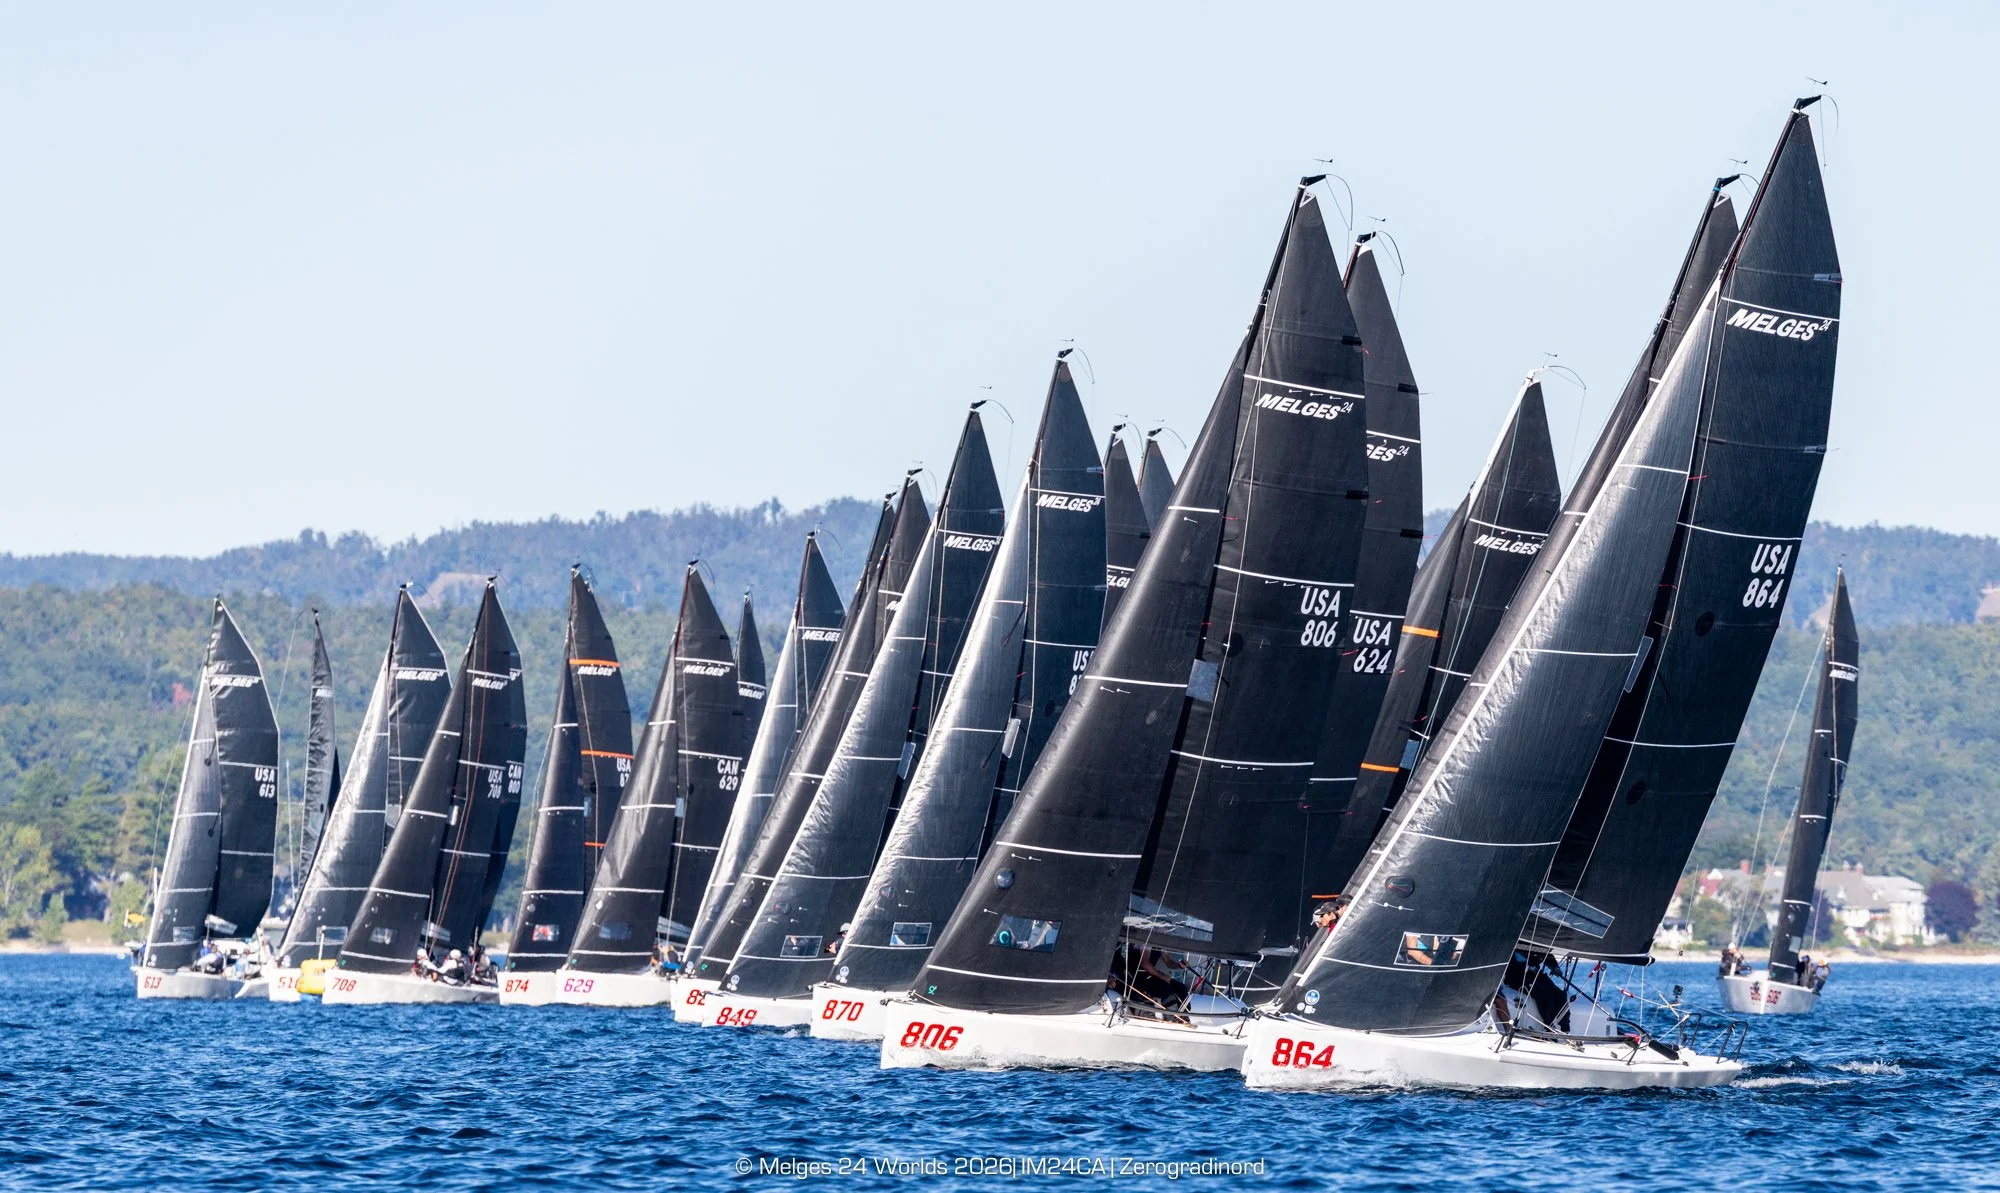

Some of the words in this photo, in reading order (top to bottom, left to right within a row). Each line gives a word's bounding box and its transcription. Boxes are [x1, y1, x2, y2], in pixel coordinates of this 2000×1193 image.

[1750, 543, 1792, 574] USA
[1300, 586, 1341, 618] USA
[1743, 578, 1785, 609] 864
[1300, 620, 1338, 648] 806
[1352, 618, 1393, 647] USA
[1072, 650, 1095, 671] US
[1352, 647, 1393, 675] 624
[616, 757, 632, 773] USA
[717, 758, 740, 775] CAN
[254, 767, 275, 783] USA
[488, 769, 503, 784] USA
[619, 773, 630, 788] 87
[719, 774, 739, 791] 629
[258, 783, 276, 799] 613
[144, 976, 162, 989] 613
[332, 977, 357, 992] 708
[505, 979, 529, 993] 874
[564, 978, 594, 994] 629
[686, 989, 706, 1006] 82
[716, 1007, 758, 1027] 849
[822, 1000, 864, 1022] 870
[900, 1021, 964, 1051] 806
[1271, 1037, 1336, 1070] 864
